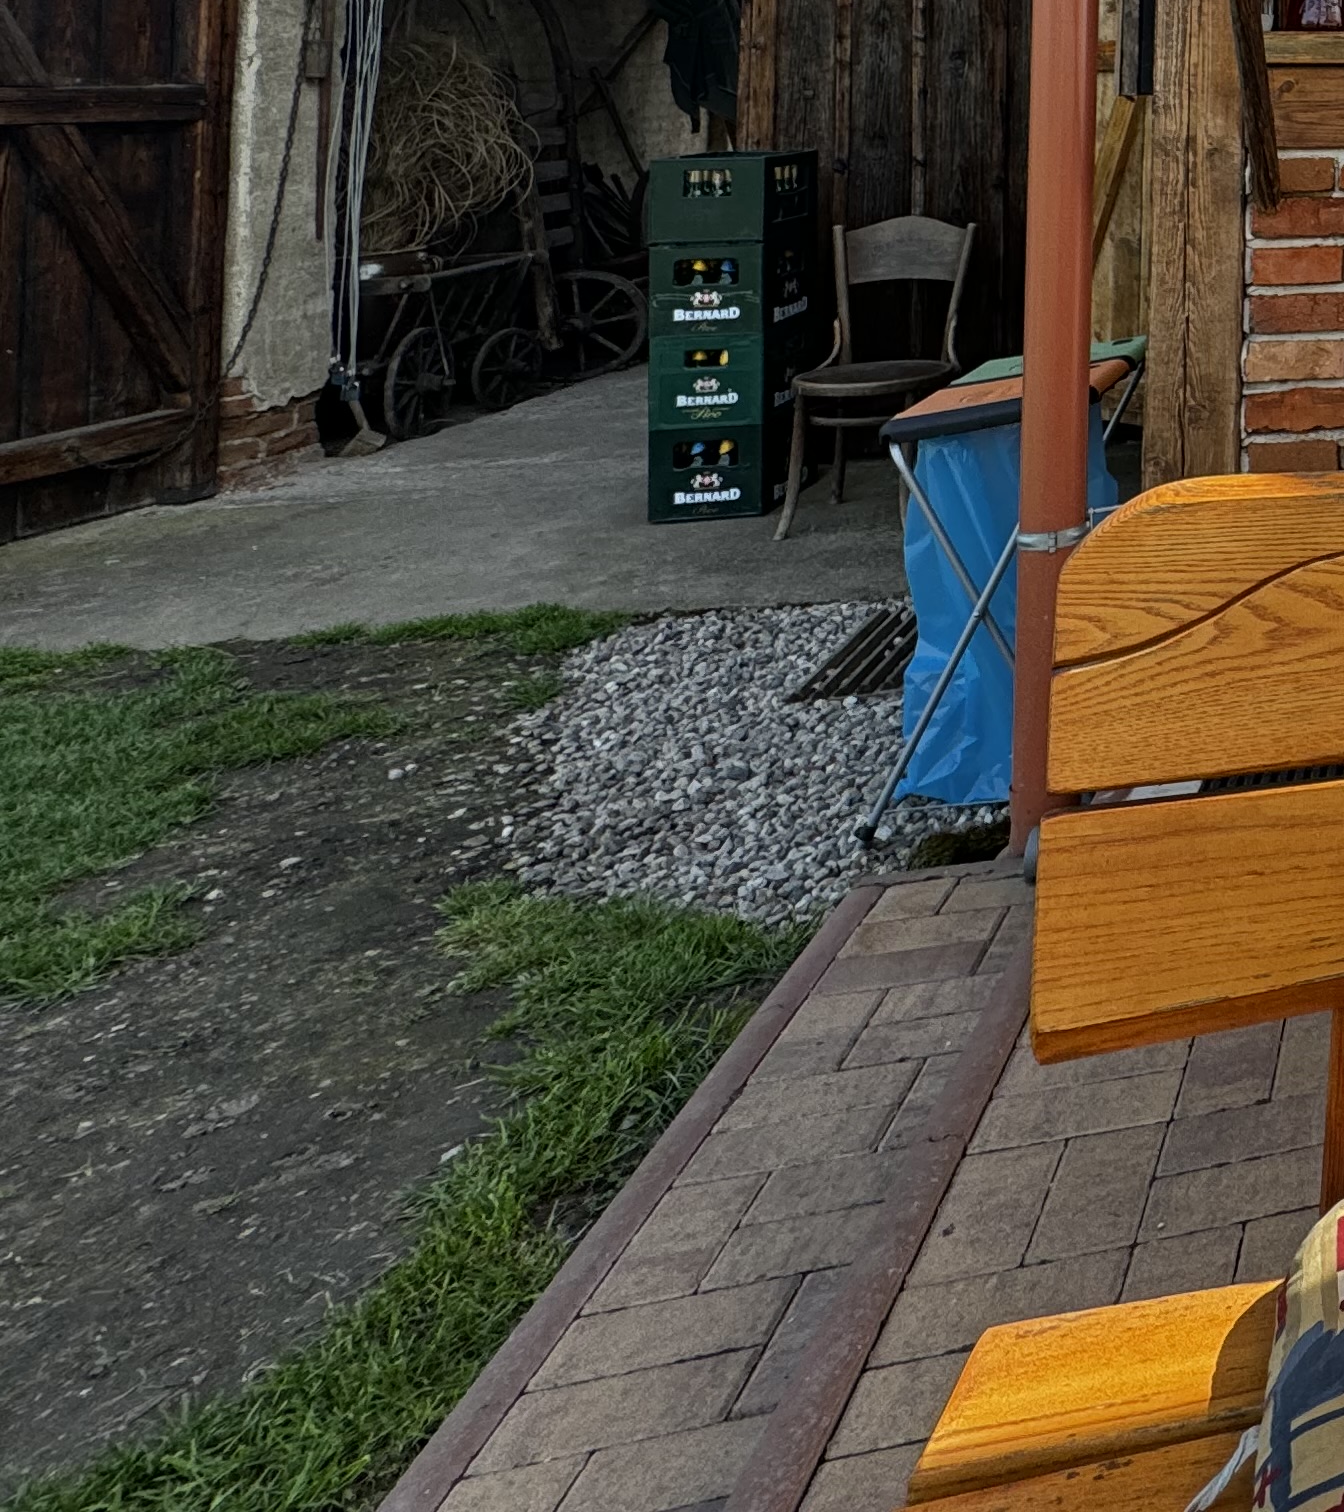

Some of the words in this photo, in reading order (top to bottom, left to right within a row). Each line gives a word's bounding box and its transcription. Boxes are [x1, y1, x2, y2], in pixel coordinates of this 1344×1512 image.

[672, 306, 741, 322] BERNARD
[675, 391, 739, 408] BERNARD
[672, 487, 742, 505] BERNARD
